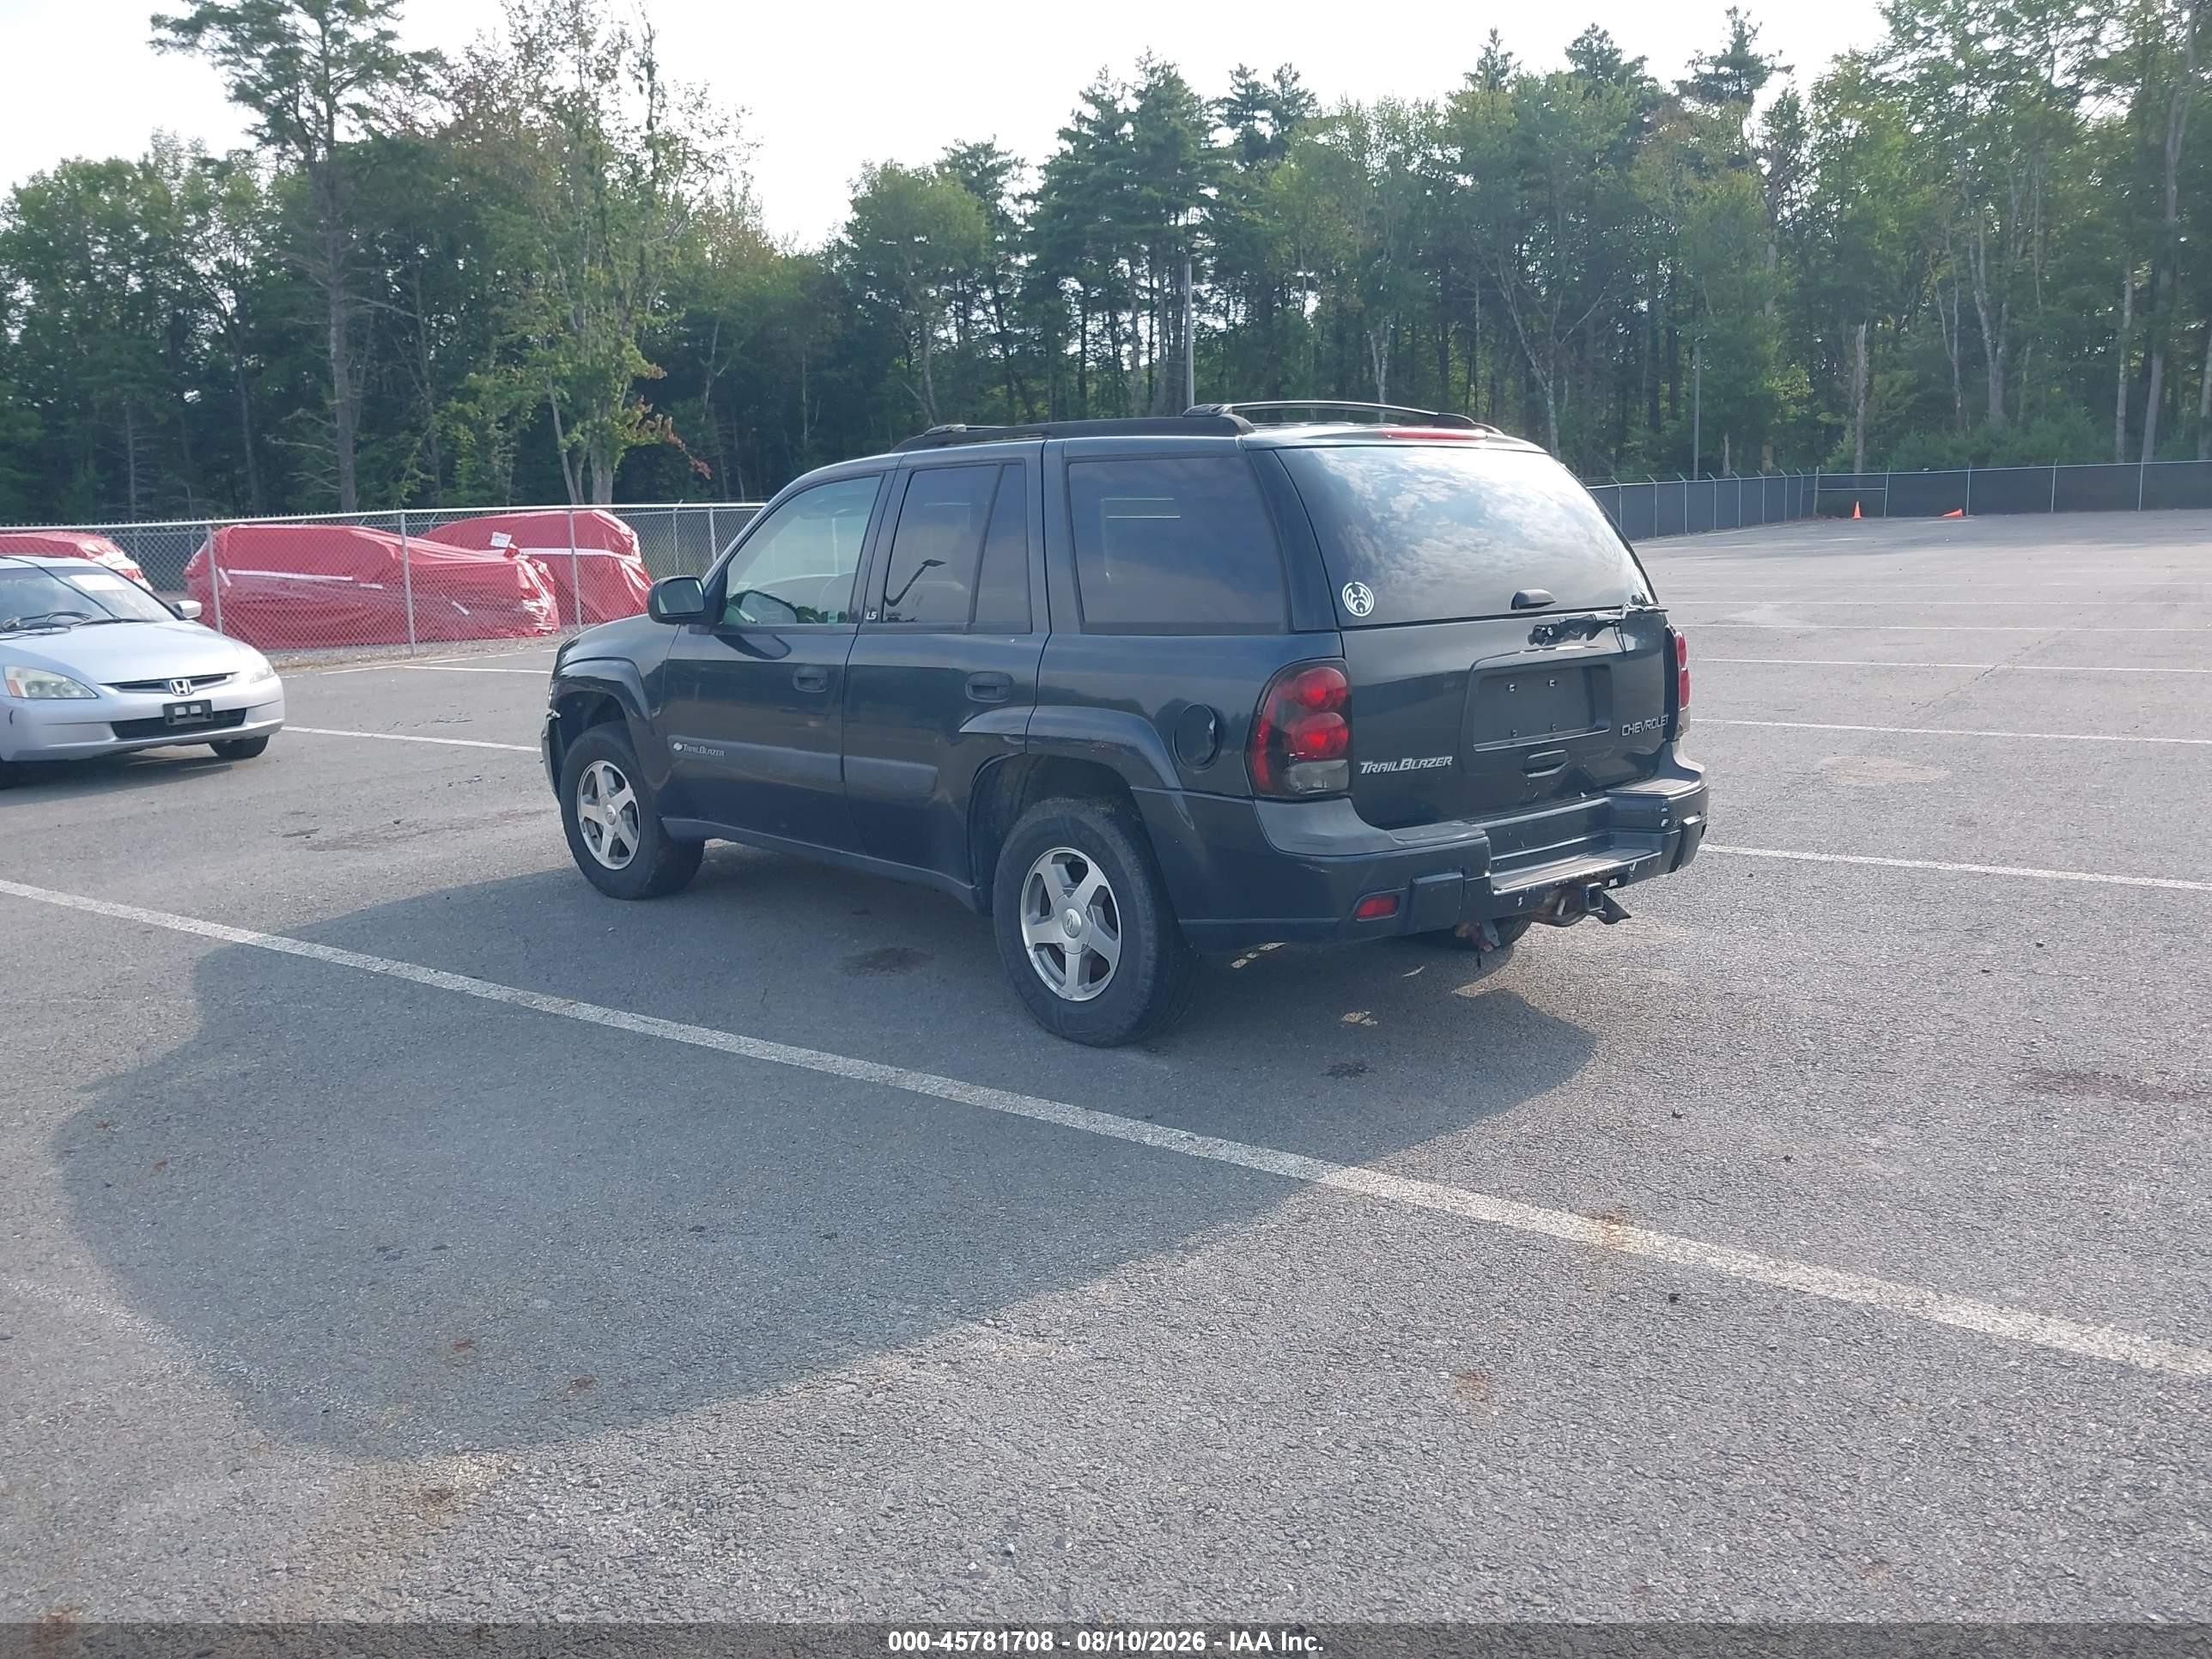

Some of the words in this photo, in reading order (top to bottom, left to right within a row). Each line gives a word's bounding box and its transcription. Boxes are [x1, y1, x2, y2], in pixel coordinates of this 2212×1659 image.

[866, 611, 878, 620] LS
[1621, 714, 1669, 736] CHEVROLET
[1359, 756, 1453, 775] TRAILBLAZER
